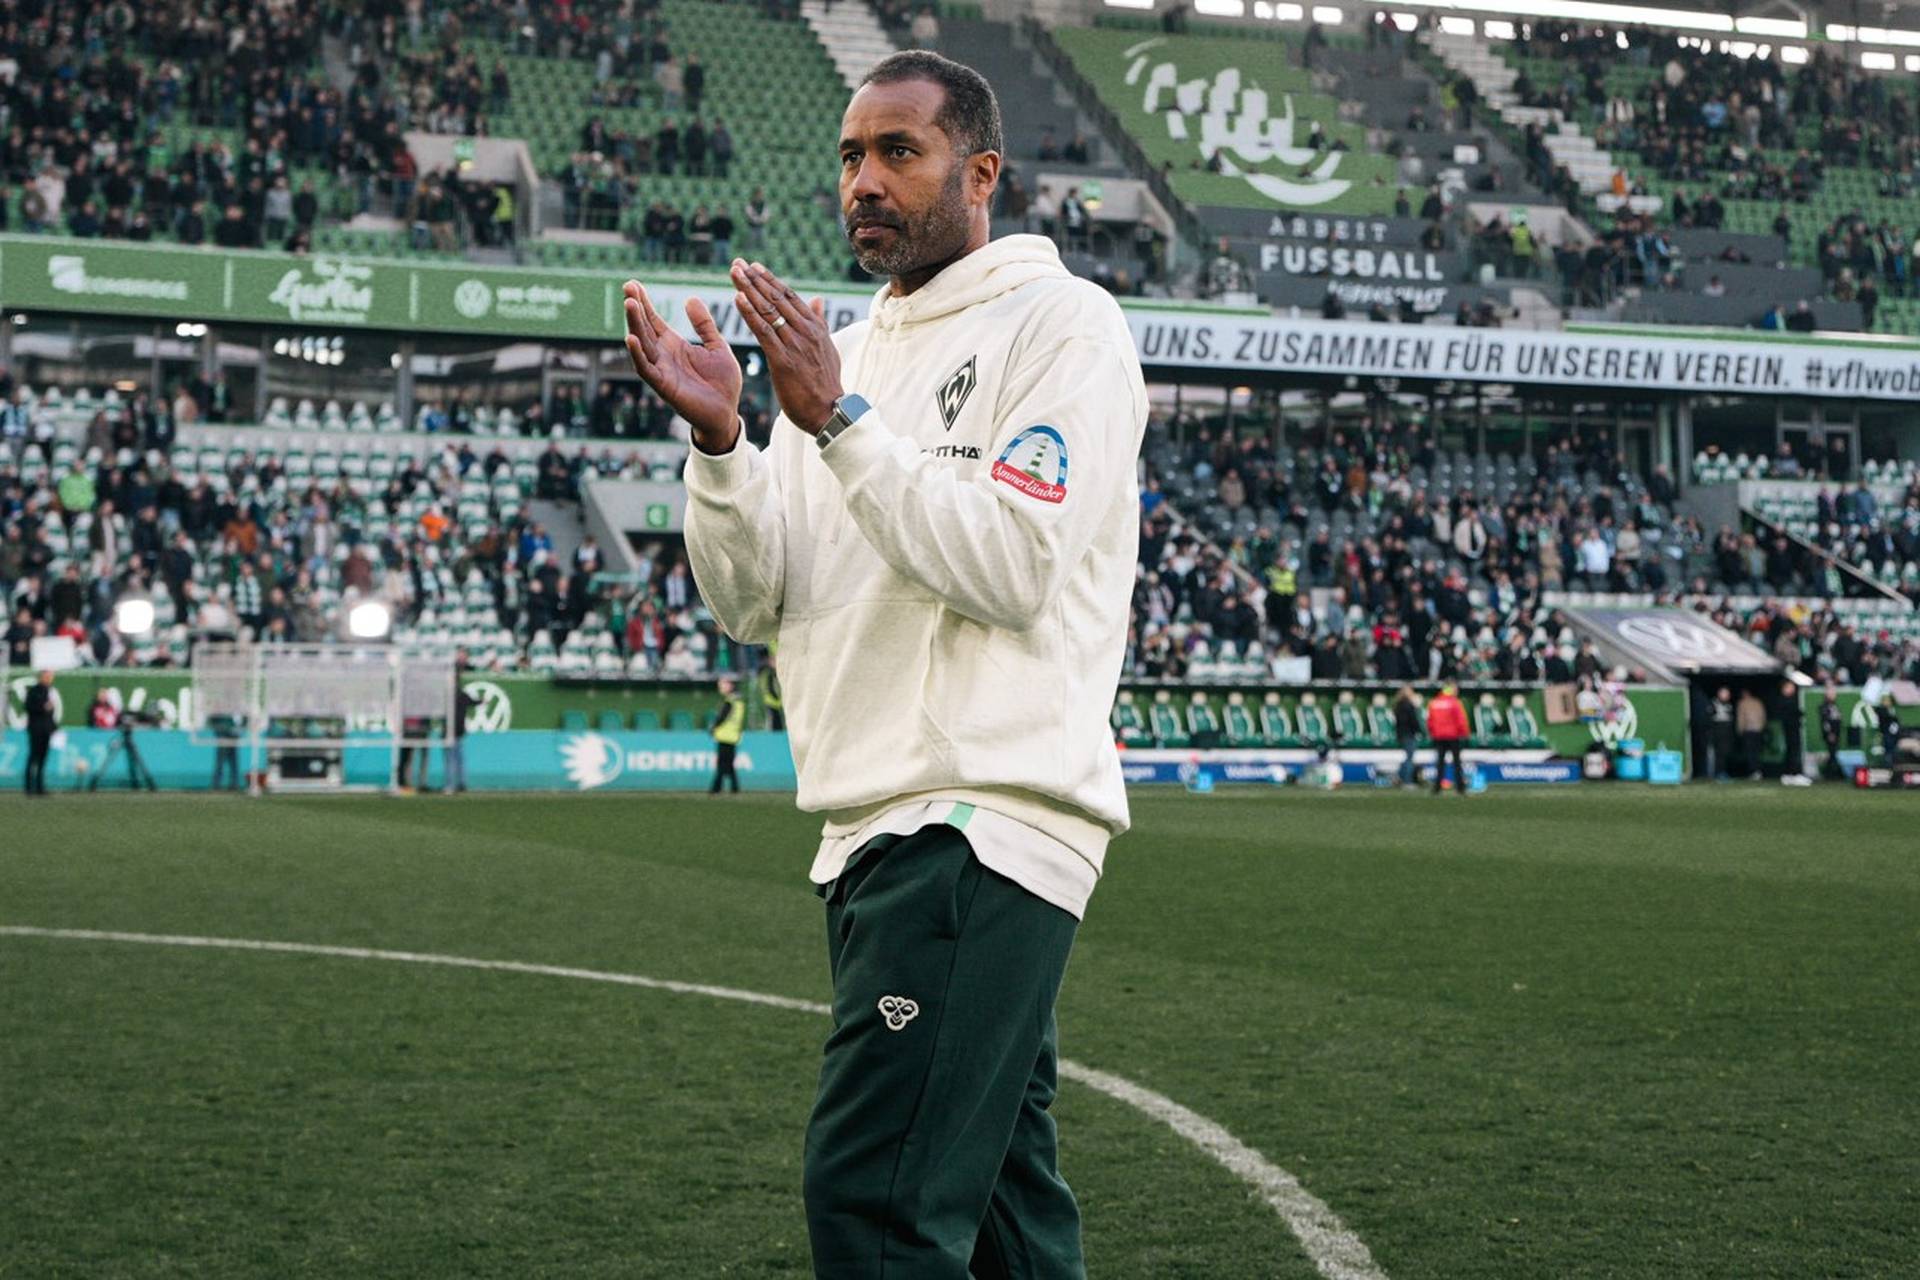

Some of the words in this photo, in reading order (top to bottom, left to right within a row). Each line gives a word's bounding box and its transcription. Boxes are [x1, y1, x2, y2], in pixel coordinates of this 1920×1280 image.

[1269, 216, 1388, 242] ARBEIT
[1260, 244, 1444, 281] FUSSBALL
[1143, 325, 1220, 360] UNS.
[1235, 329, 1432, 370] ZUSAMMEN
[1444, 334, 1504, 373] FÜR
[1516, 344, 1663, 381] UNSEREN
[1675, 352, 1789, 387] VEREIN.
[992, 464, 1063, 500] Ammerländer
[626, 752, 753, 771] IDENTIA
